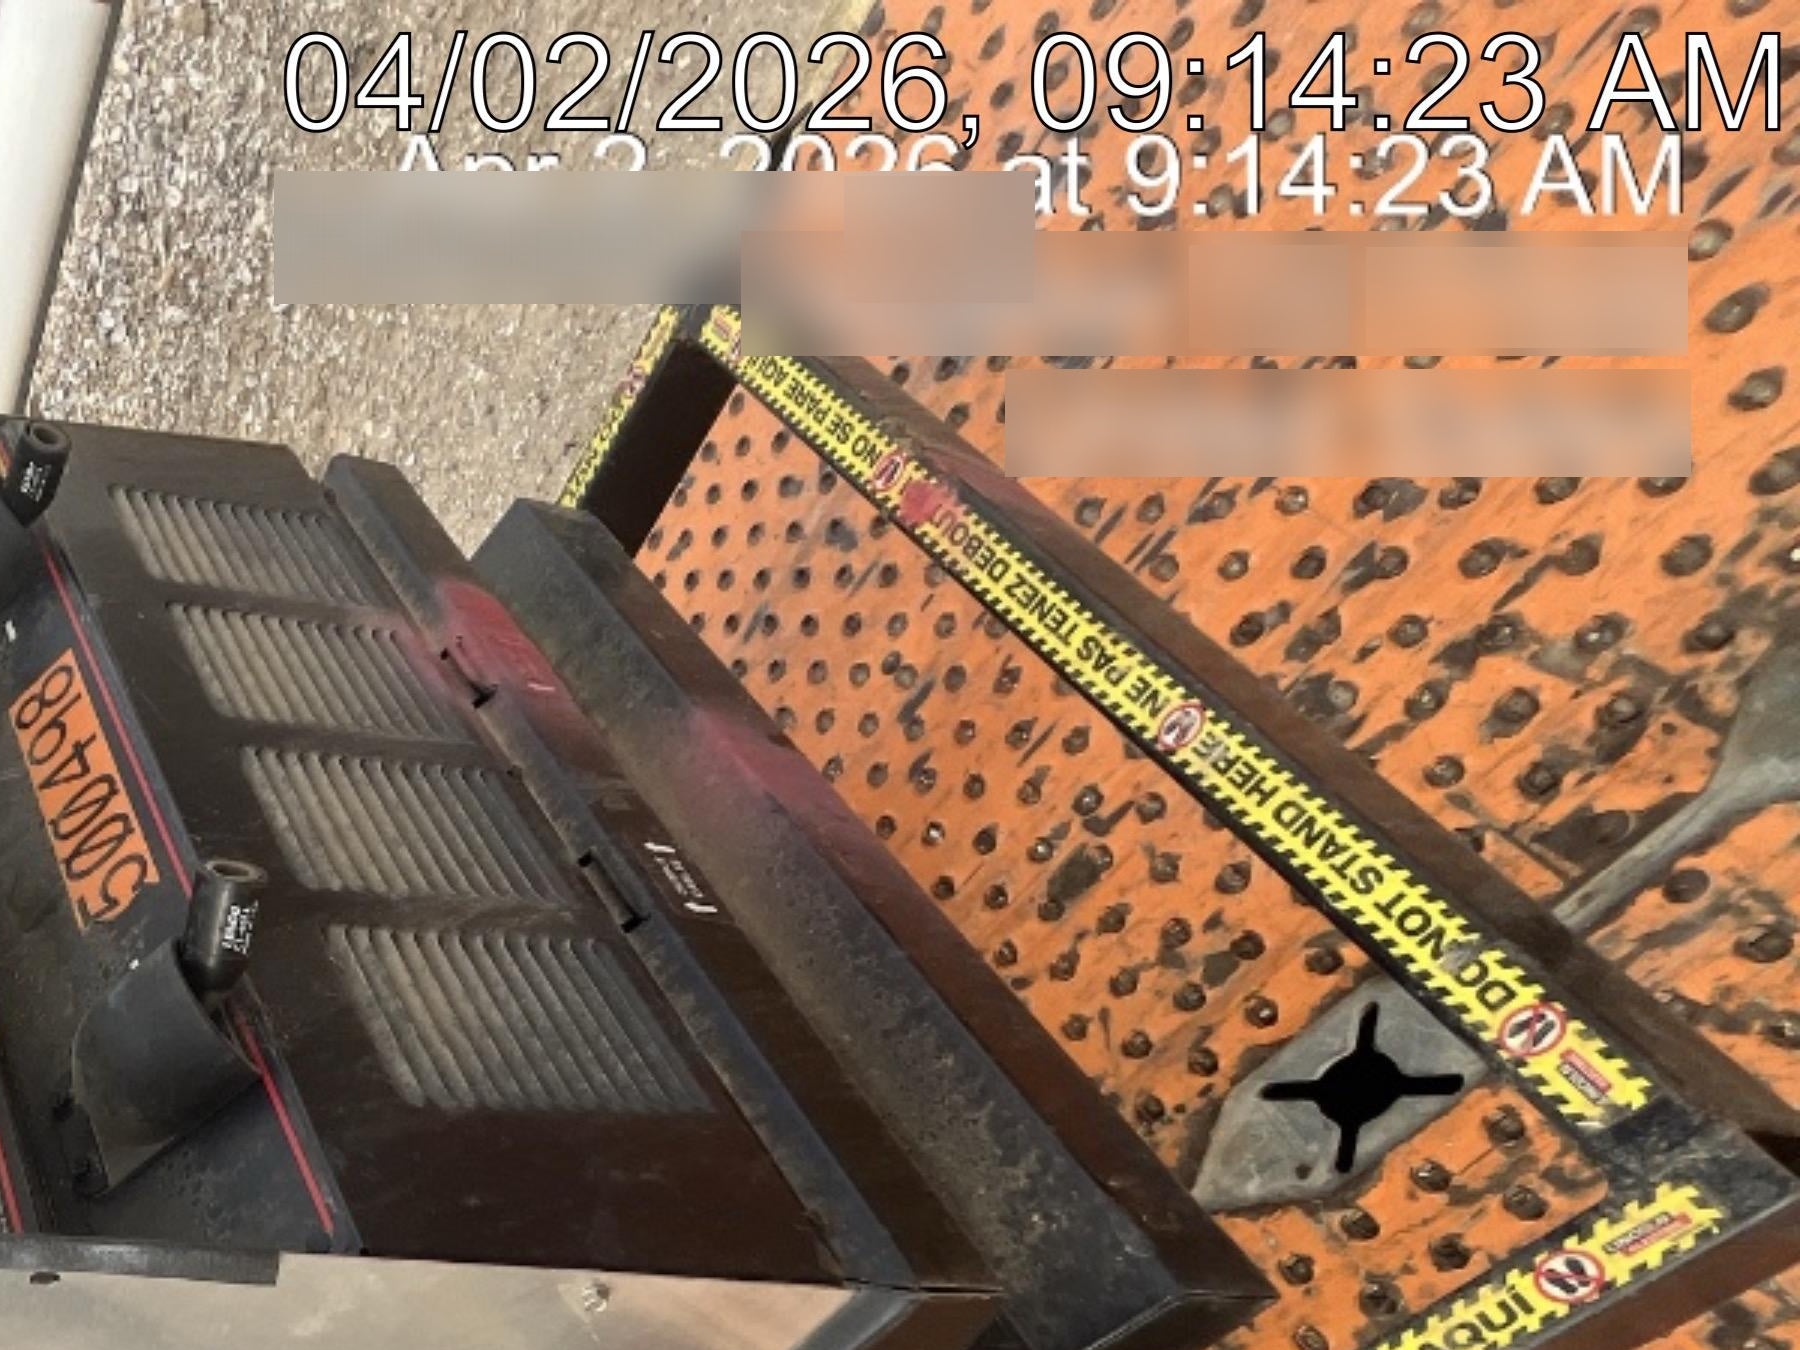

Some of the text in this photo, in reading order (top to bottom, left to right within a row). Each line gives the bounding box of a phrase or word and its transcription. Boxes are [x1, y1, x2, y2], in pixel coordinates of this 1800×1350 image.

[782, 377, 832, 425] PARE
[825, 412, 855, 445] SE
[850, 434, 883, 469] NO
[1003, 572, 1079, 647] TENEZ
[1075, 635, 1131, 687] PAS
[1123, 675, 1170, 719] NE
[1191, 730, 1517, 1012] DO NOT STAND HERE
